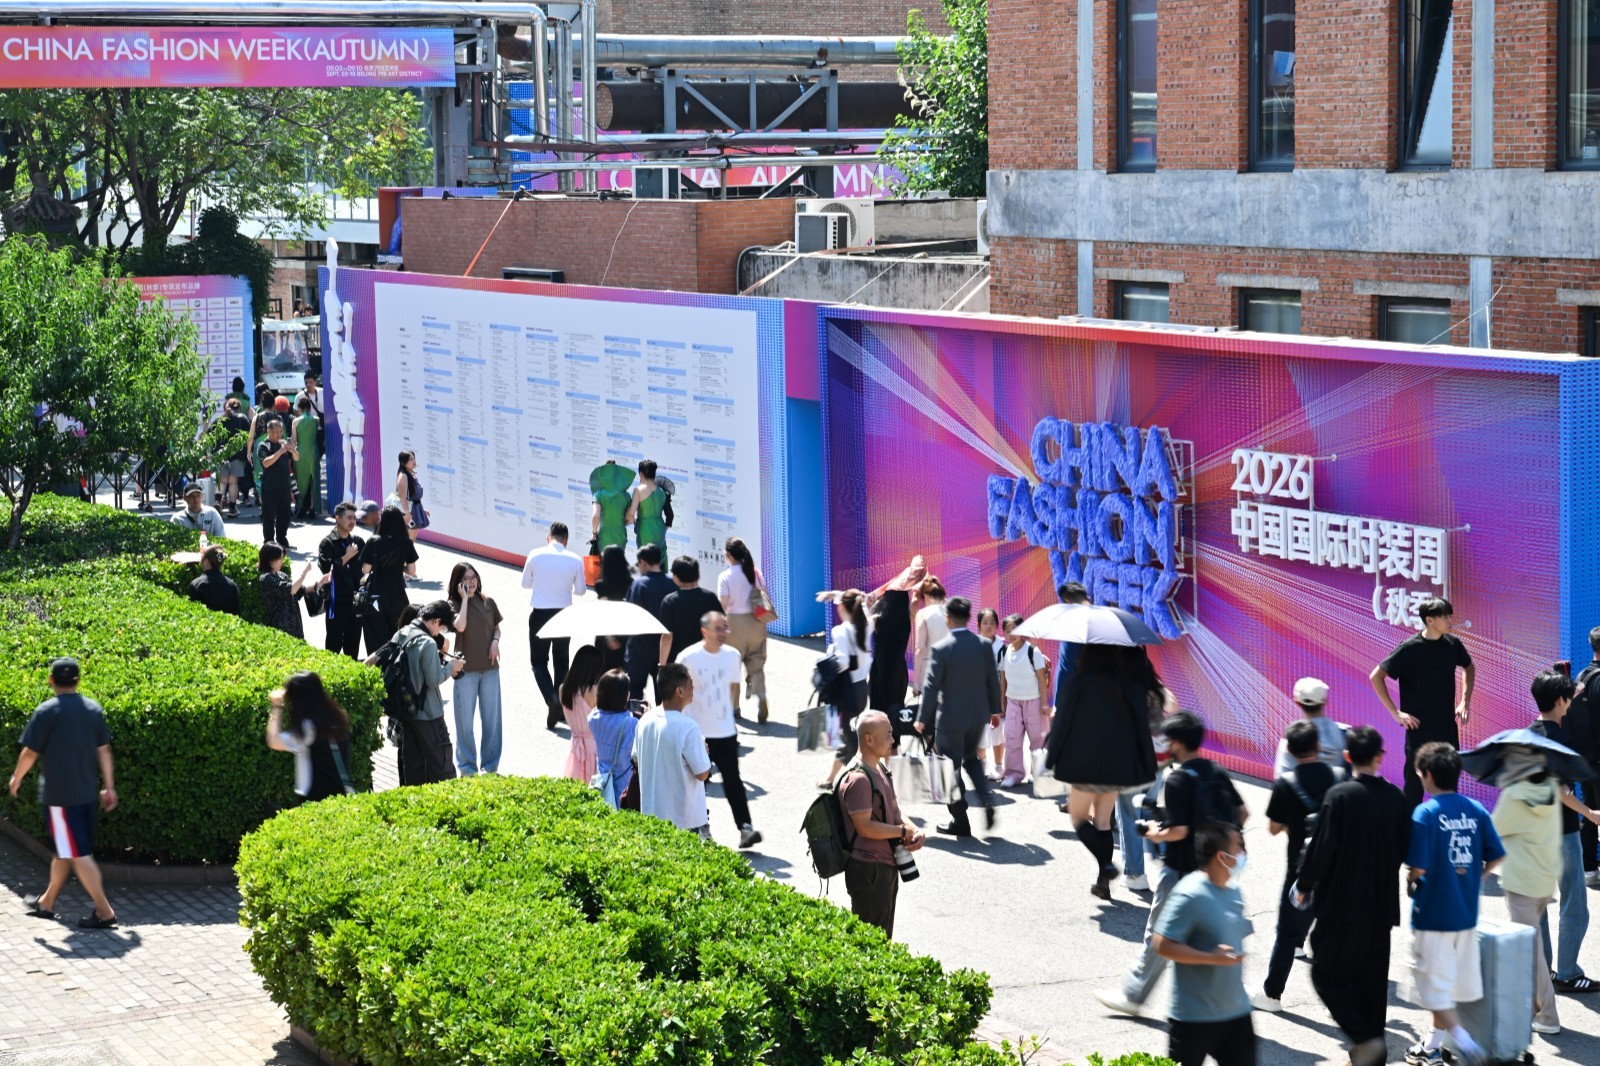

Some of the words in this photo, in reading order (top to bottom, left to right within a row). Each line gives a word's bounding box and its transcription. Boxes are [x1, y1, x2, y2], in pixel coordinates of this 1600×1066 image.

[3, 37, 94, 61] CHINA
[102, 37, 220, 61] FASHION
[1031, 416, 1178, 500] CHINA
[1231, 449, 1311, 500] 2026
[987, 474, 1176, 573] FASHION
[1231, 500, 1448, 586] 中国国际时装周
[1049, 550, 1182, 640] WEEK
[1438, 812, 1478, 834] Sunday
